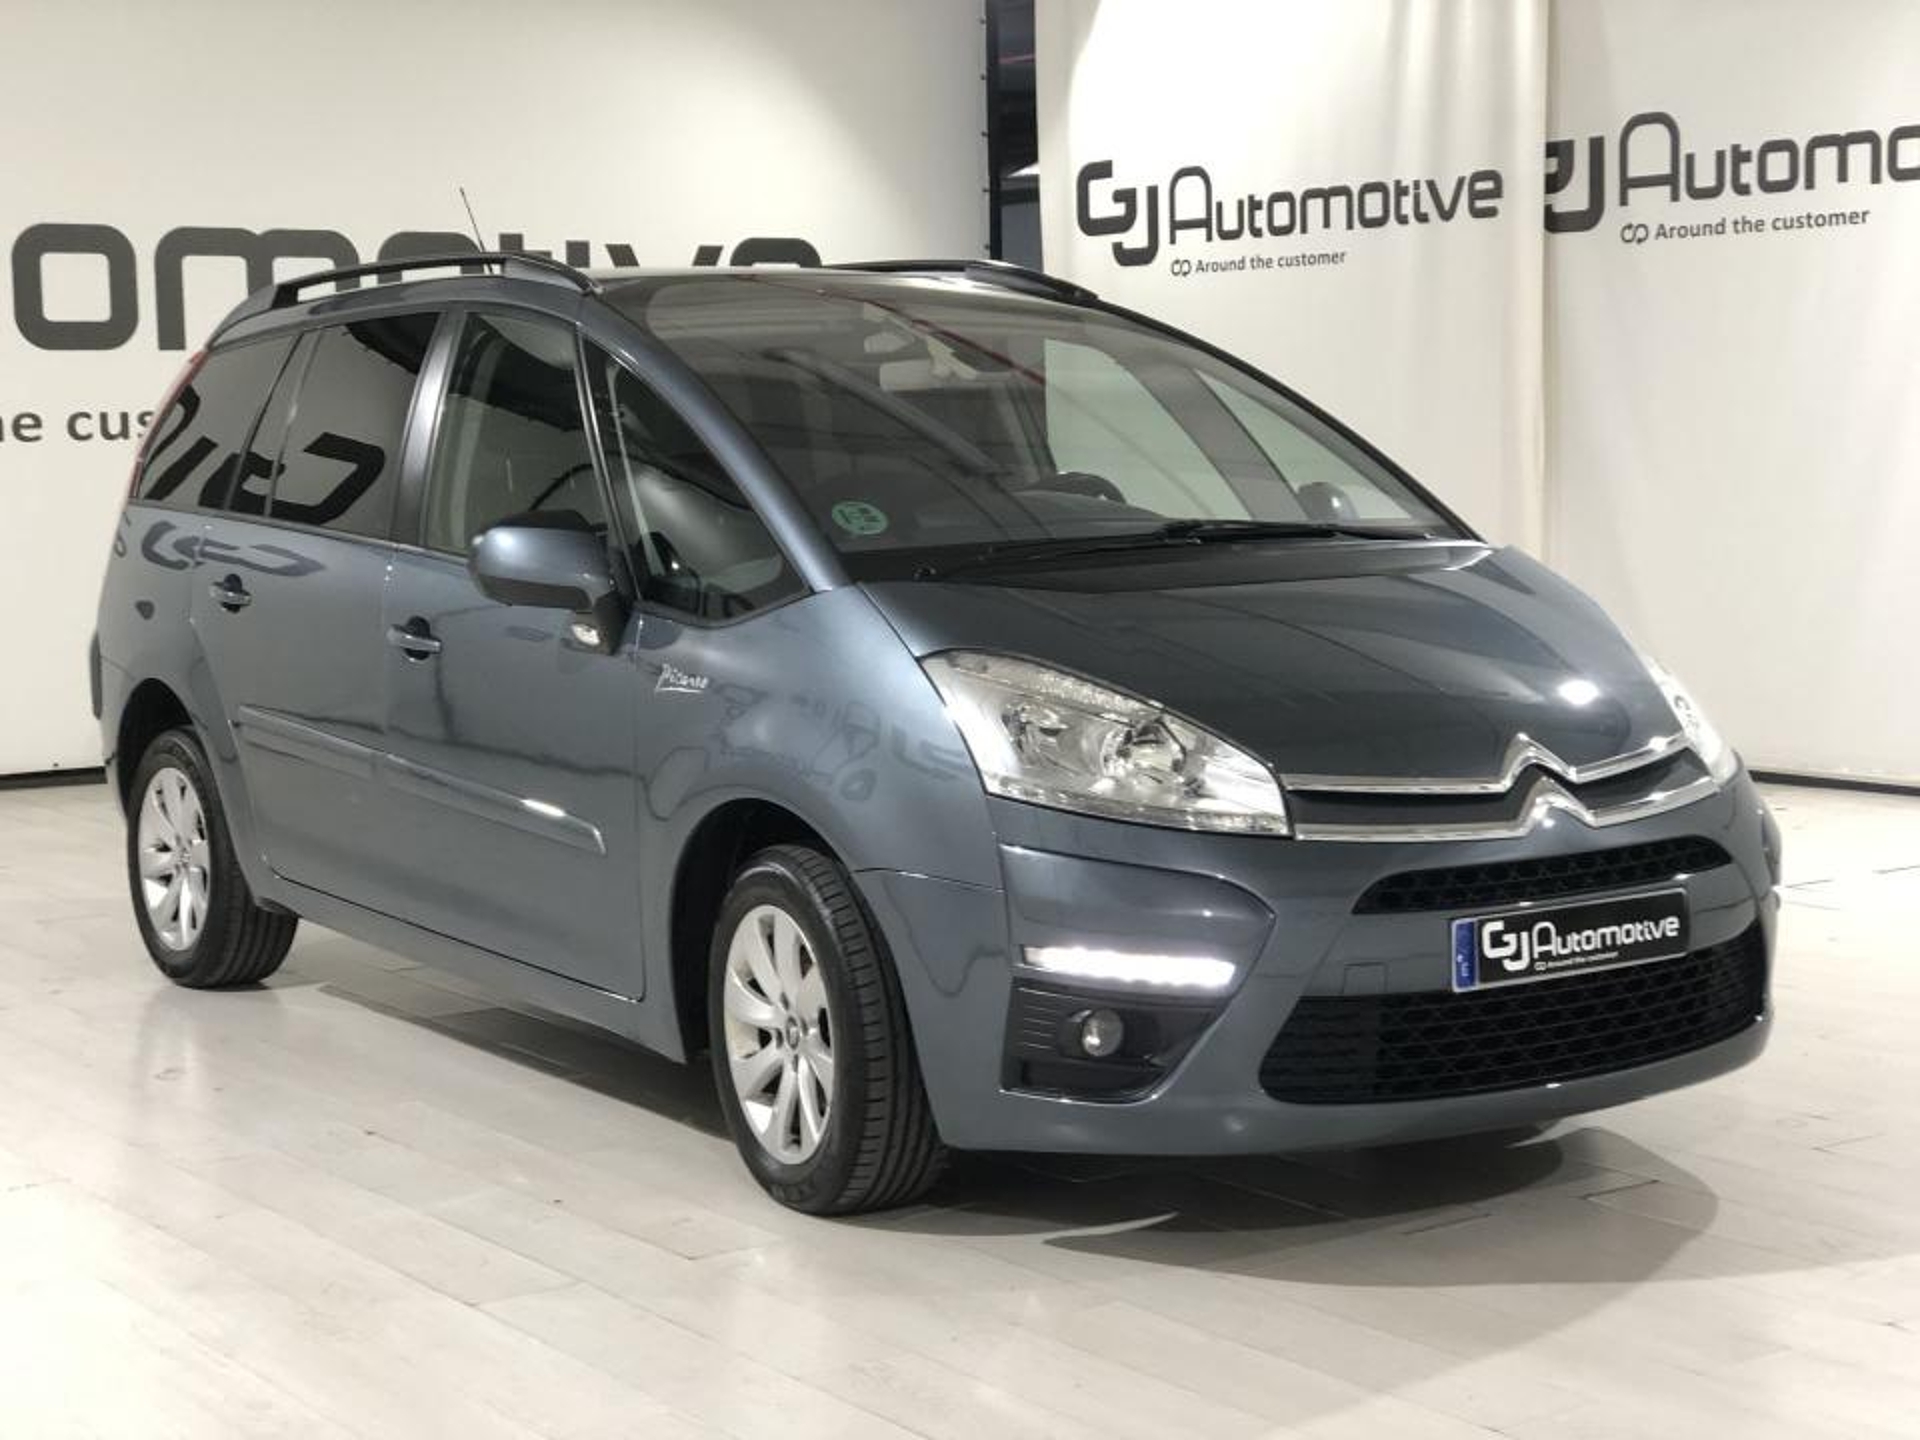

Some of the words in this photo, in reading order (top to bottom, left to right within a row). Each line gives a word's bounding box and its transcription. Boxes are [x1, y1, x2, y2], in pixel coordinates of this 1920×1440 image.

[1655, 217, 1727, 240] Around
[1733, 215, 1765, 234] the
[1771, 209, 1870, 231] customer
[1195, 255, 1246, 274] Around
[1250, 254, 1274, 270] the
[1277, 251, 1347, 268] customer
